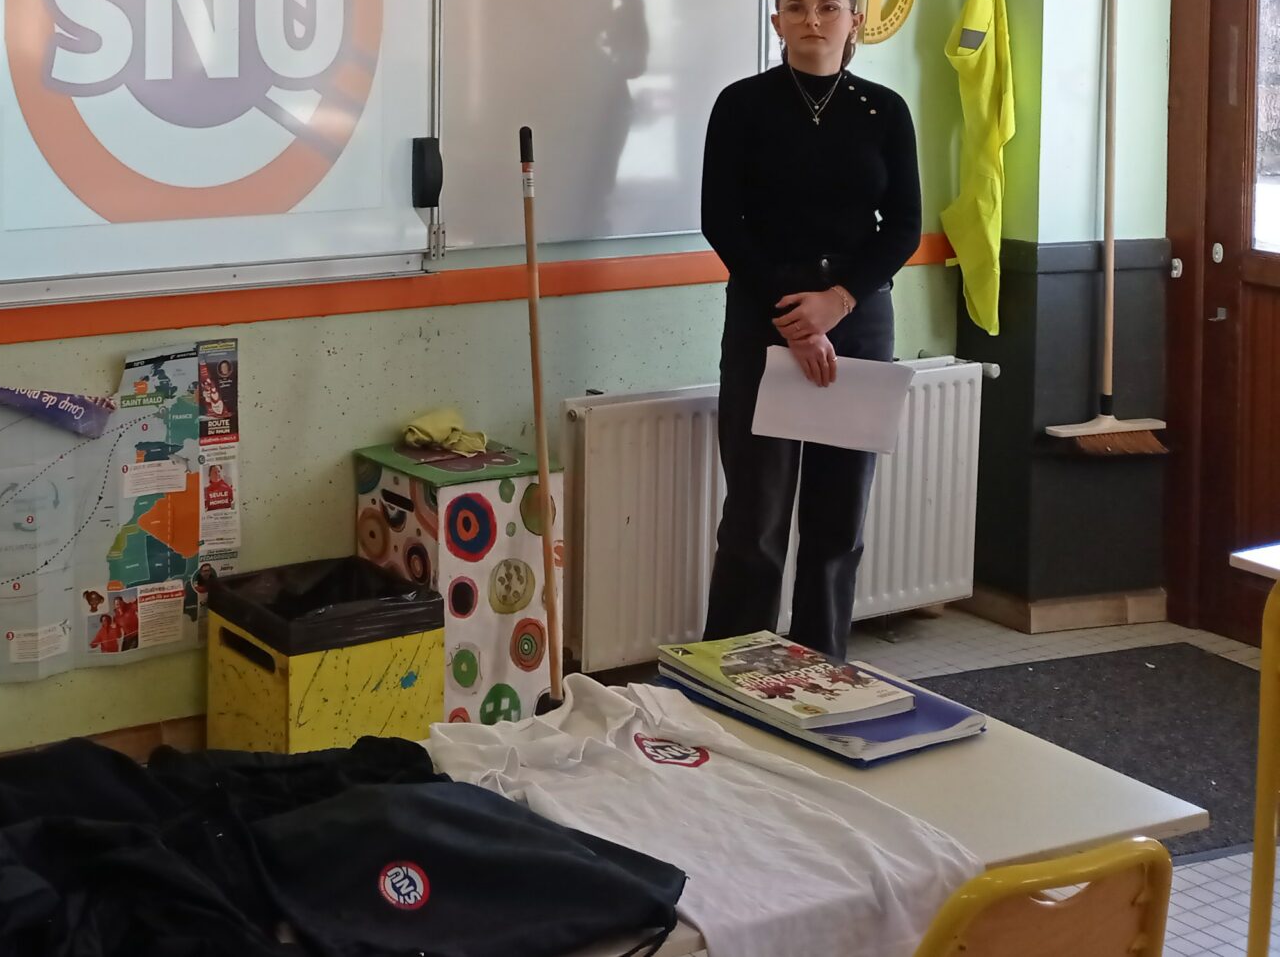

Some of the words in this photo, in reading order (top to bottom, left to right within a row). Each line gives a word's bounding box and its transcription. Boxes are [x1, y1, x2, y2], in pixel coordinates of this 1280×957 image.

[41, 392, 57, 409] de
[58, 397, 85, 420] Coup
[143, 396, 162, 404] MALO
[208, 419, 230, 427] ROUTE
[209, 491, 229, 499] SEULE
[644, 743, 698, 761] SNU
[387, 866, 422, 904] SNU
